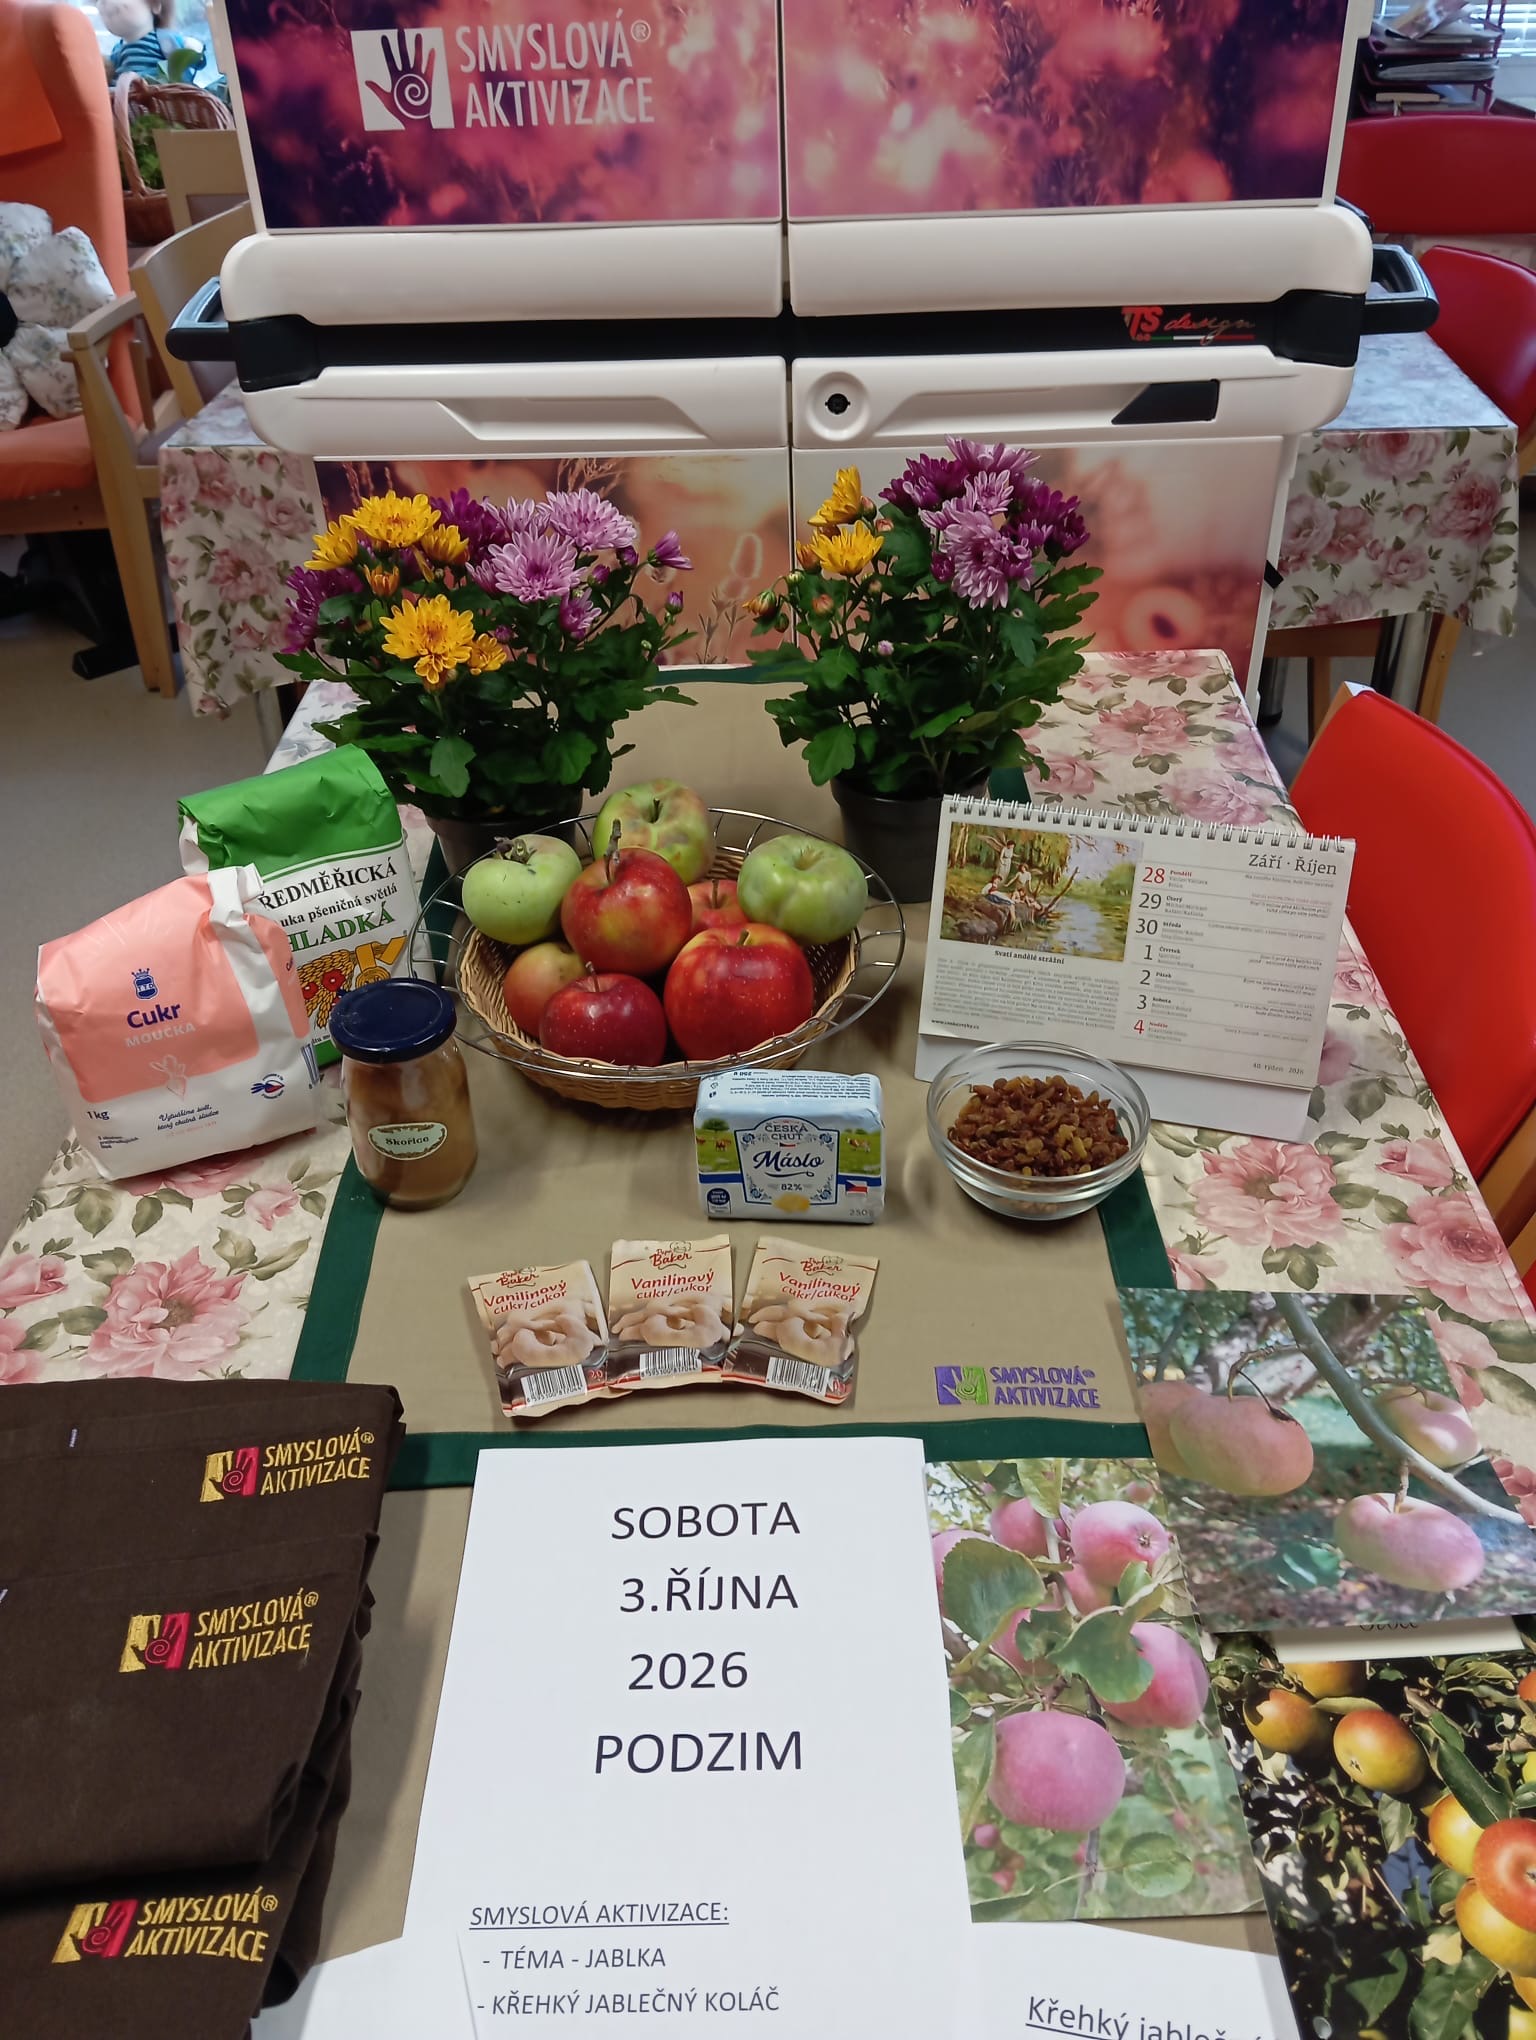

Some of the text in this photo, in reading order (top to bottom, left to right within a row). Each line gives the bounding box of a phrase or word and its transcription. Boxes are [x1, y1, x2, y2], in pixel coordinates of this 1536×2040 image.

[465, 77, 655, 128] AKTIVIZACE
[1121, 305, 1163, 339] TS
[1142, 866, 1165, 884] 28
[1249, 854, 1337, 876] Září Říjen
[257, 857, 398, 911] ŘEDMĚŘICKÁ
[280, 883, 398, 927] uka pšeničná světlá
[1138, 893, 1162, 910] 29
[1135, 918, 1158, 935] 30
[1143, 945, 1153, 960] 1
[1139, 969, 1151, 985] 2
[1136, 994, 1147, 1010] 3
[127, 1004, 181, 1028] Cukr
[1133, 1019, 1145, 1035] 4
[94, 1110, 110, 1121] kg
[752, 1149, 824, 1172] Máslo
[649, 1252, 692, 1267] Baker
[800, 1260, 842, 1272] Baker
[496, 1273, 539, 1286] Baker
[636, 1283, 712, 1300] cukr/cukor
[493, 1290, 567, 1315] cukr/cukor
[782, 1286, 855, 1303] cukr/cukor
[994, 1387, 1101, 1409] AKTIVIZACE
[260, 1457, 372, 1496] AKTIVIZACE
[611, 1501, 801, 1540] SOBOTA
[620, 1566, 799, 1612] 3.ŘÍJNA
[188, 1624, 313, 1671] AKTIVIZACE
[628, 1651, 748, 1690] 2026
[595, 1731, 801, 1774] PODZIM
[470, 1901, 729, 1926] SMYSLOVÁ AKTIVIZACE:
[123, 1925, 269, 1963] AKTIVIZACE
[500, 1945, 565, 1969] TÉMA
[585, 1947, 666, 1968] JABLKA
[492, 1989, 580, 2015] KŘEHKÝ
[585, 1987, 698, 2014] JABLEČNÝ
[705, 1985, 780, 2012] KOLÁČ
[1028, 1996, 1130, 2040] Křehký
